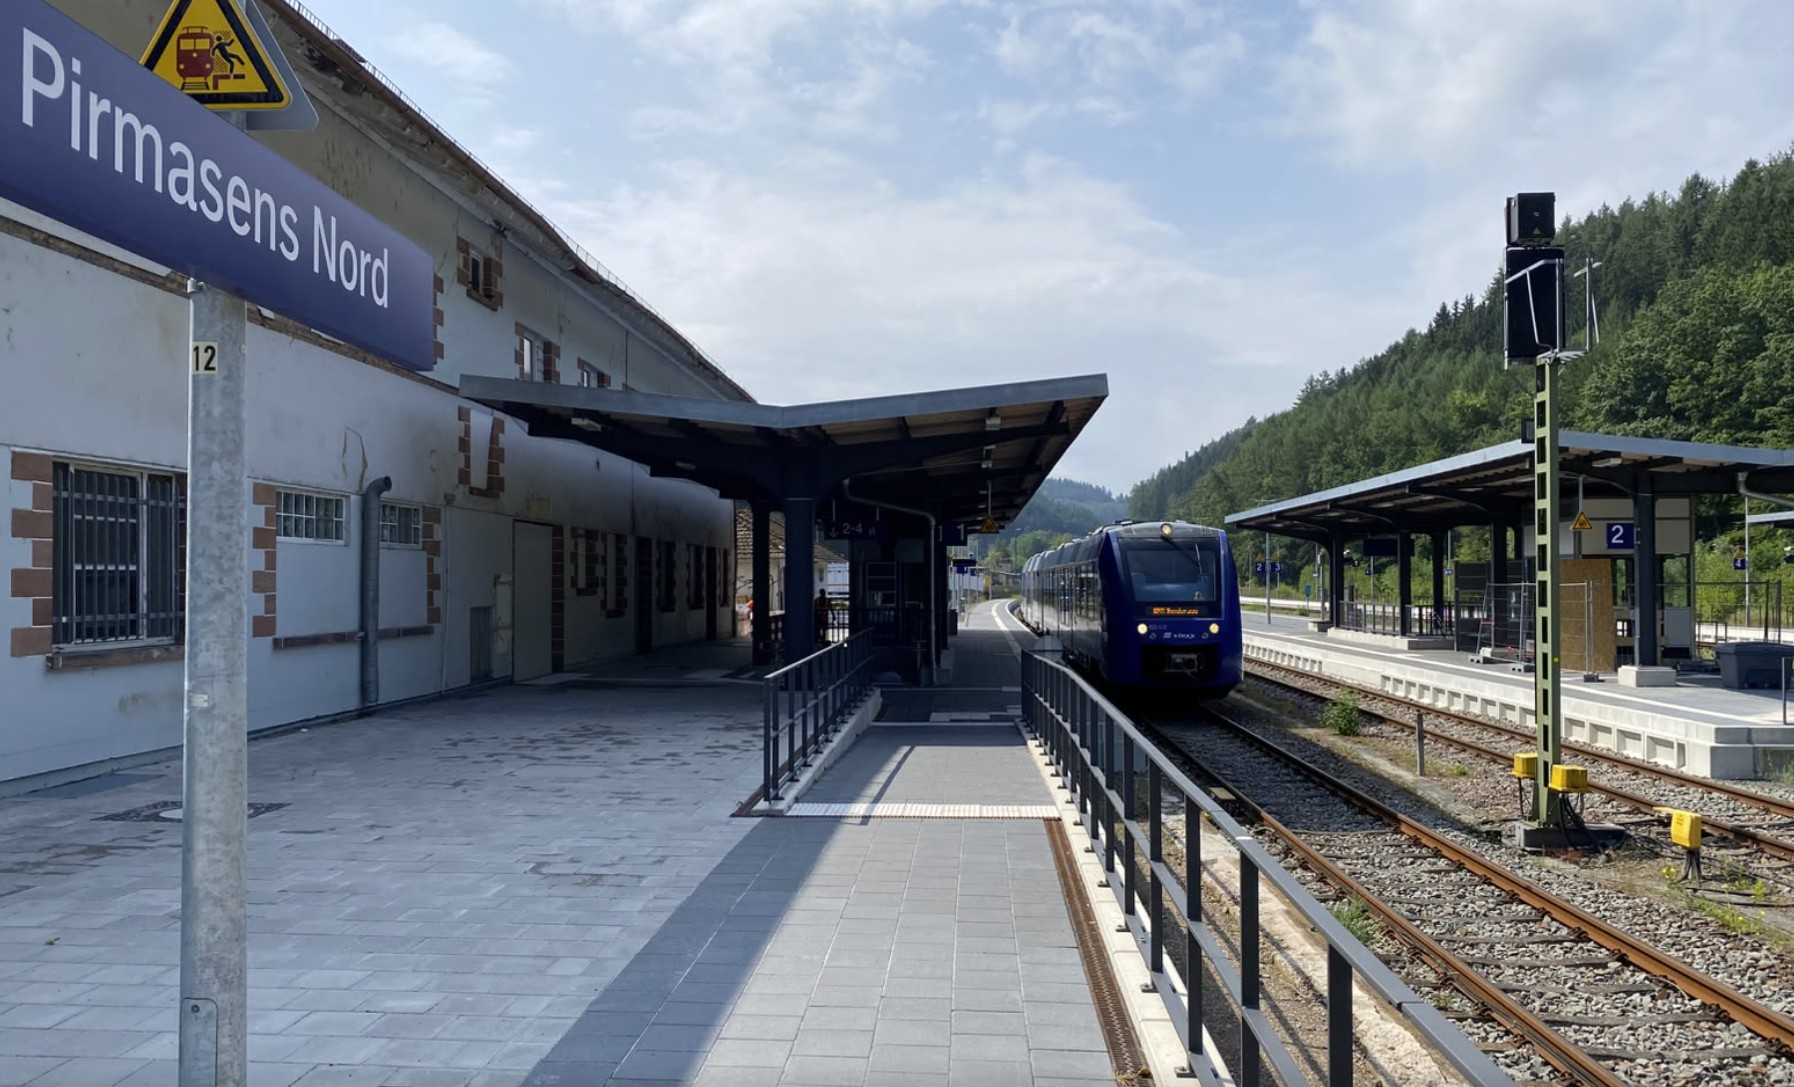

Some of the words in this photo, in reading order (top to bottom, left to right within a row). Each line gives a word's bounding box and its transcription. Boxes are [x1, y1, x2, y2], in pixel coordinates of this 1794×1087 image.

[21, 26, 299, 262] Pirmasens
[312, 205, 389, 309] Nord
[193, 344, 216, 371] 12
[842, 521, 863, 535] 2-4
[956, 523, 965, 541] 1
[1611, 524, 1624, 544] 2
[1256, 562, 1263, 572] 2
[1275, 562, 1281, 572] 3
[1734, 558, 1741, 568] 4
